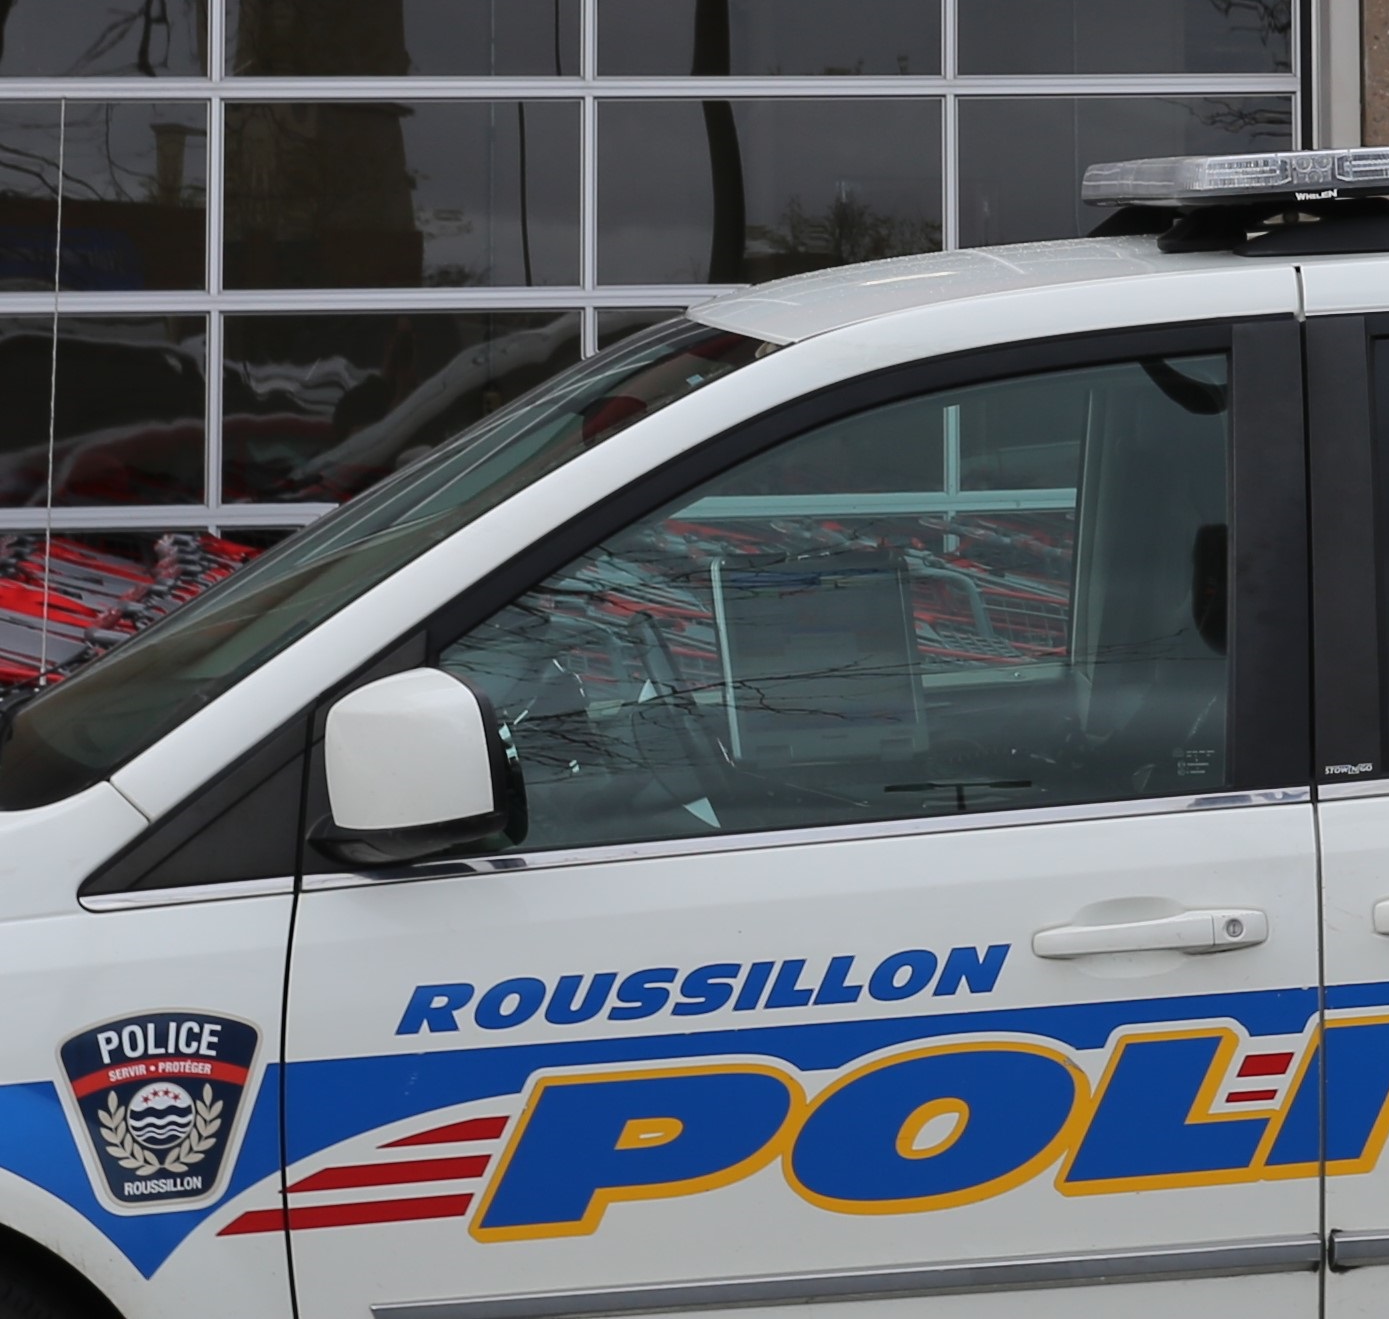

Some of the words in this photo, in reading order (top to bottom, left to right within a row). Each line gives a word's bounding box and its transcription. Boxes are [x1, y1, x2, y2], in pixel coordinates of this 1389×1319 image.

[396, 944, 1011, 1035] ROUSSILLON
[97, 1021, 222, 1064] POLICE
[109, 1065, 146, 1081] SERVIR
[158, 1060, 212, 1075] PROTÉGER
[124, 1176, 202, 1196] ROUSSILLON
